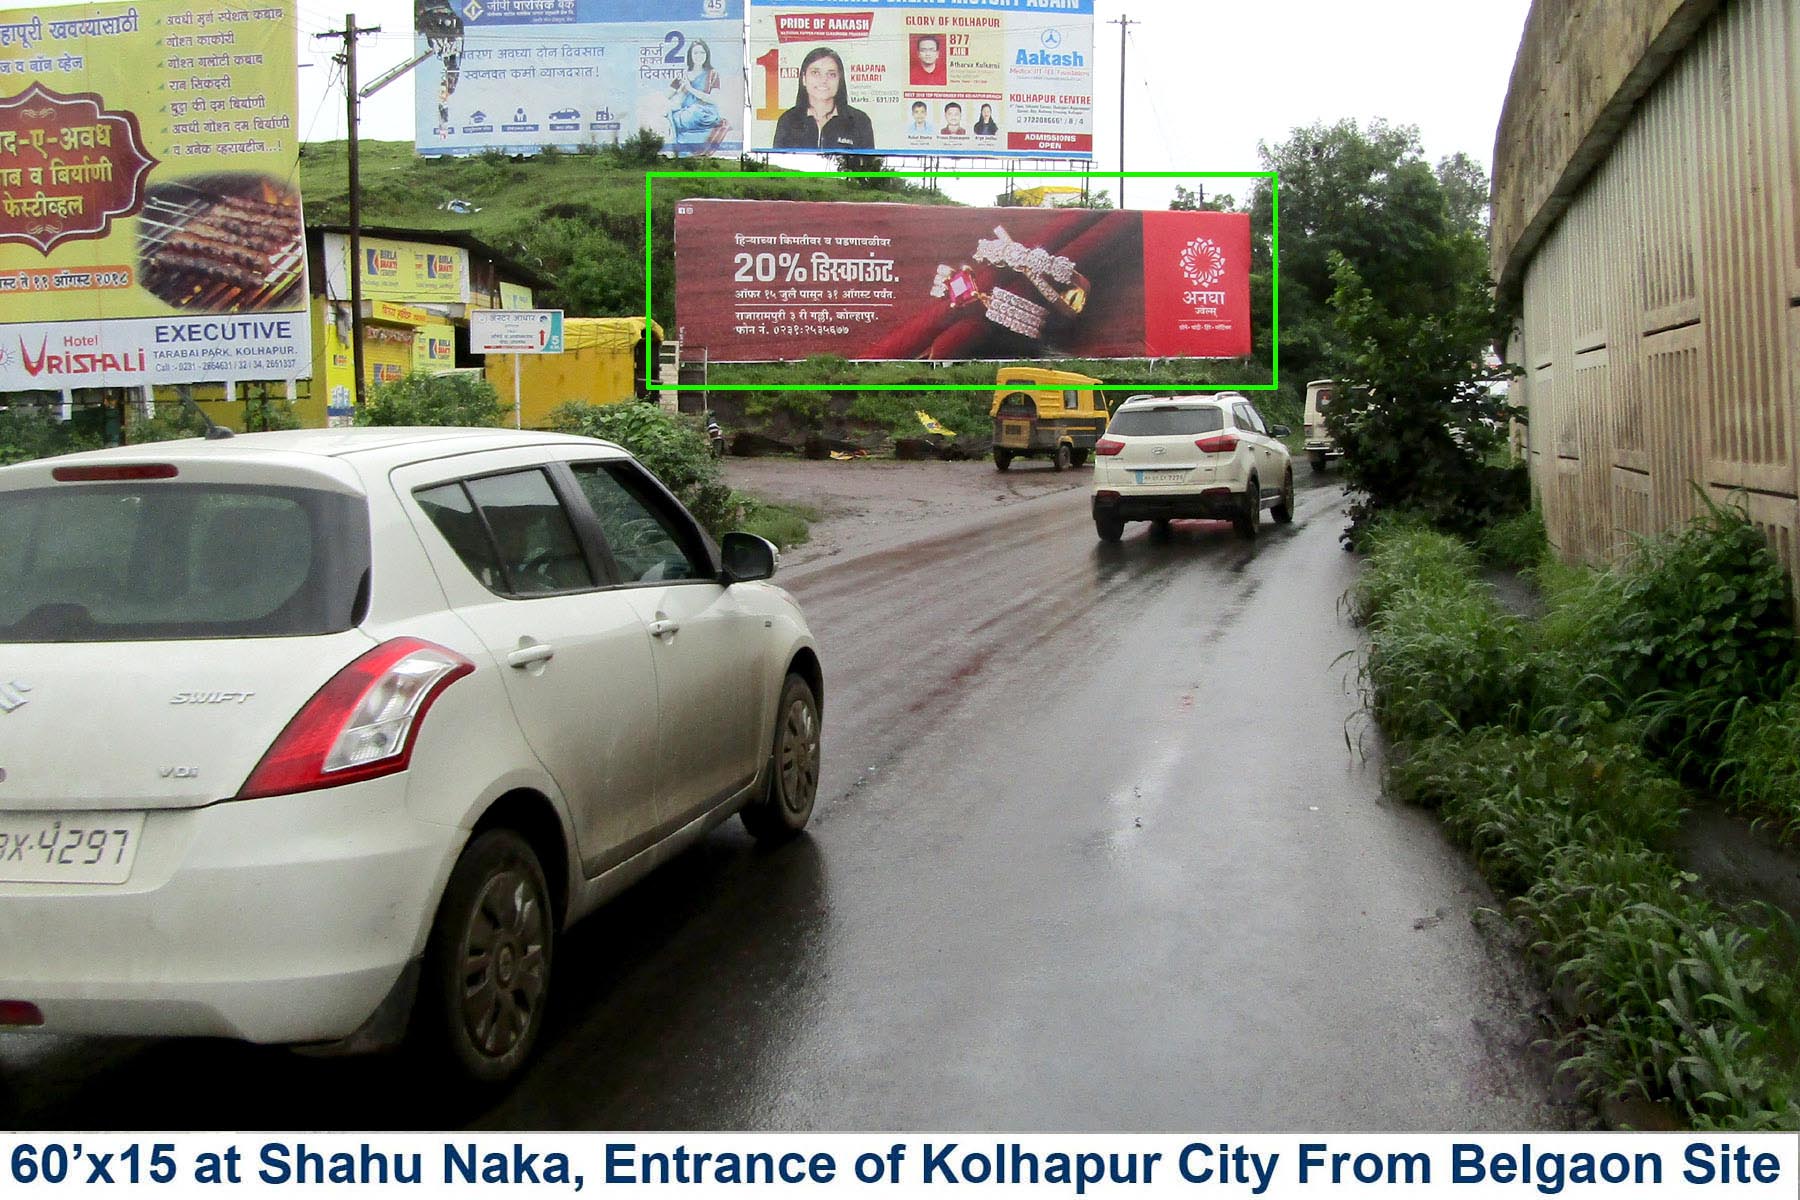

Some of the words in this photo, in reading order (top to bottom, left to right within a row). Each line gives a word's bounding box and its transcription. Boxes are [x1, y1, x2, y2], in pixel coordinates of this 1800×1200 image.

[780, 18, 810, 29] PRIDE
[813, 19, 825, 29] OF
[829, 19, 869, 30] AAKASH
[906, 16, 935, 26] GLORY
[938, 16, 949, 26] OF
[952, 17, 1000, 28] KOLHAPUR
[950, 34, 969, 45] 877
[536, 45, 558, 58] दोन
[640, 43, 664, 57] कर्ज
[664, 31, 685, 63] 2
[1016, 49, 1084, 67] Aakash
[511, 66, 536, 79] कमी
[781, 68, 799, 78] AIR
[850, 64, 886, 73] KALPANA
[756, 49, 787, 120] 1
[850, 74, 882, 82] KUMARI
[1009, 94, 1056, 103] KOLHAPUR
[1060, 95, 1091, 104] CENTRE
[0, 124, 112, 159] द-ए-अवध
[1025, 133, 1076, 142] ADMISSIONS
[28, 167, 43, 185] व
[50, 155, 113, 186] बिर्याणी
[3, 191, 84, 218] फेस्टीव्हल
[780, 233, 821, 246] किमतीवर
[824, 236, 832, 245] व
[734, 252, 807, 282] 20%
[54, 269, 91, 287] ऑगस्ट
[95, 272, 129, 286] २०१८
[735, 287, 761, 299] ऑफर
[842, 287, 871, 299] ऑगस्ट
[1182, 291, 1225, 305] अनघा
[735, 309, 786, 323] राजारामपुरी
[155, 321, 292, 343] EXECUTIVE
[735, 322, 755, 334] फोन
[63, 335, 98, 347] Hotel
[552, 336, 559, 344] 5
[153, 349, 199, 359] TARABAI
[236, 345, 298, 356] KOLHAPUR.
[170, 692, 255, 704] SWIFT
